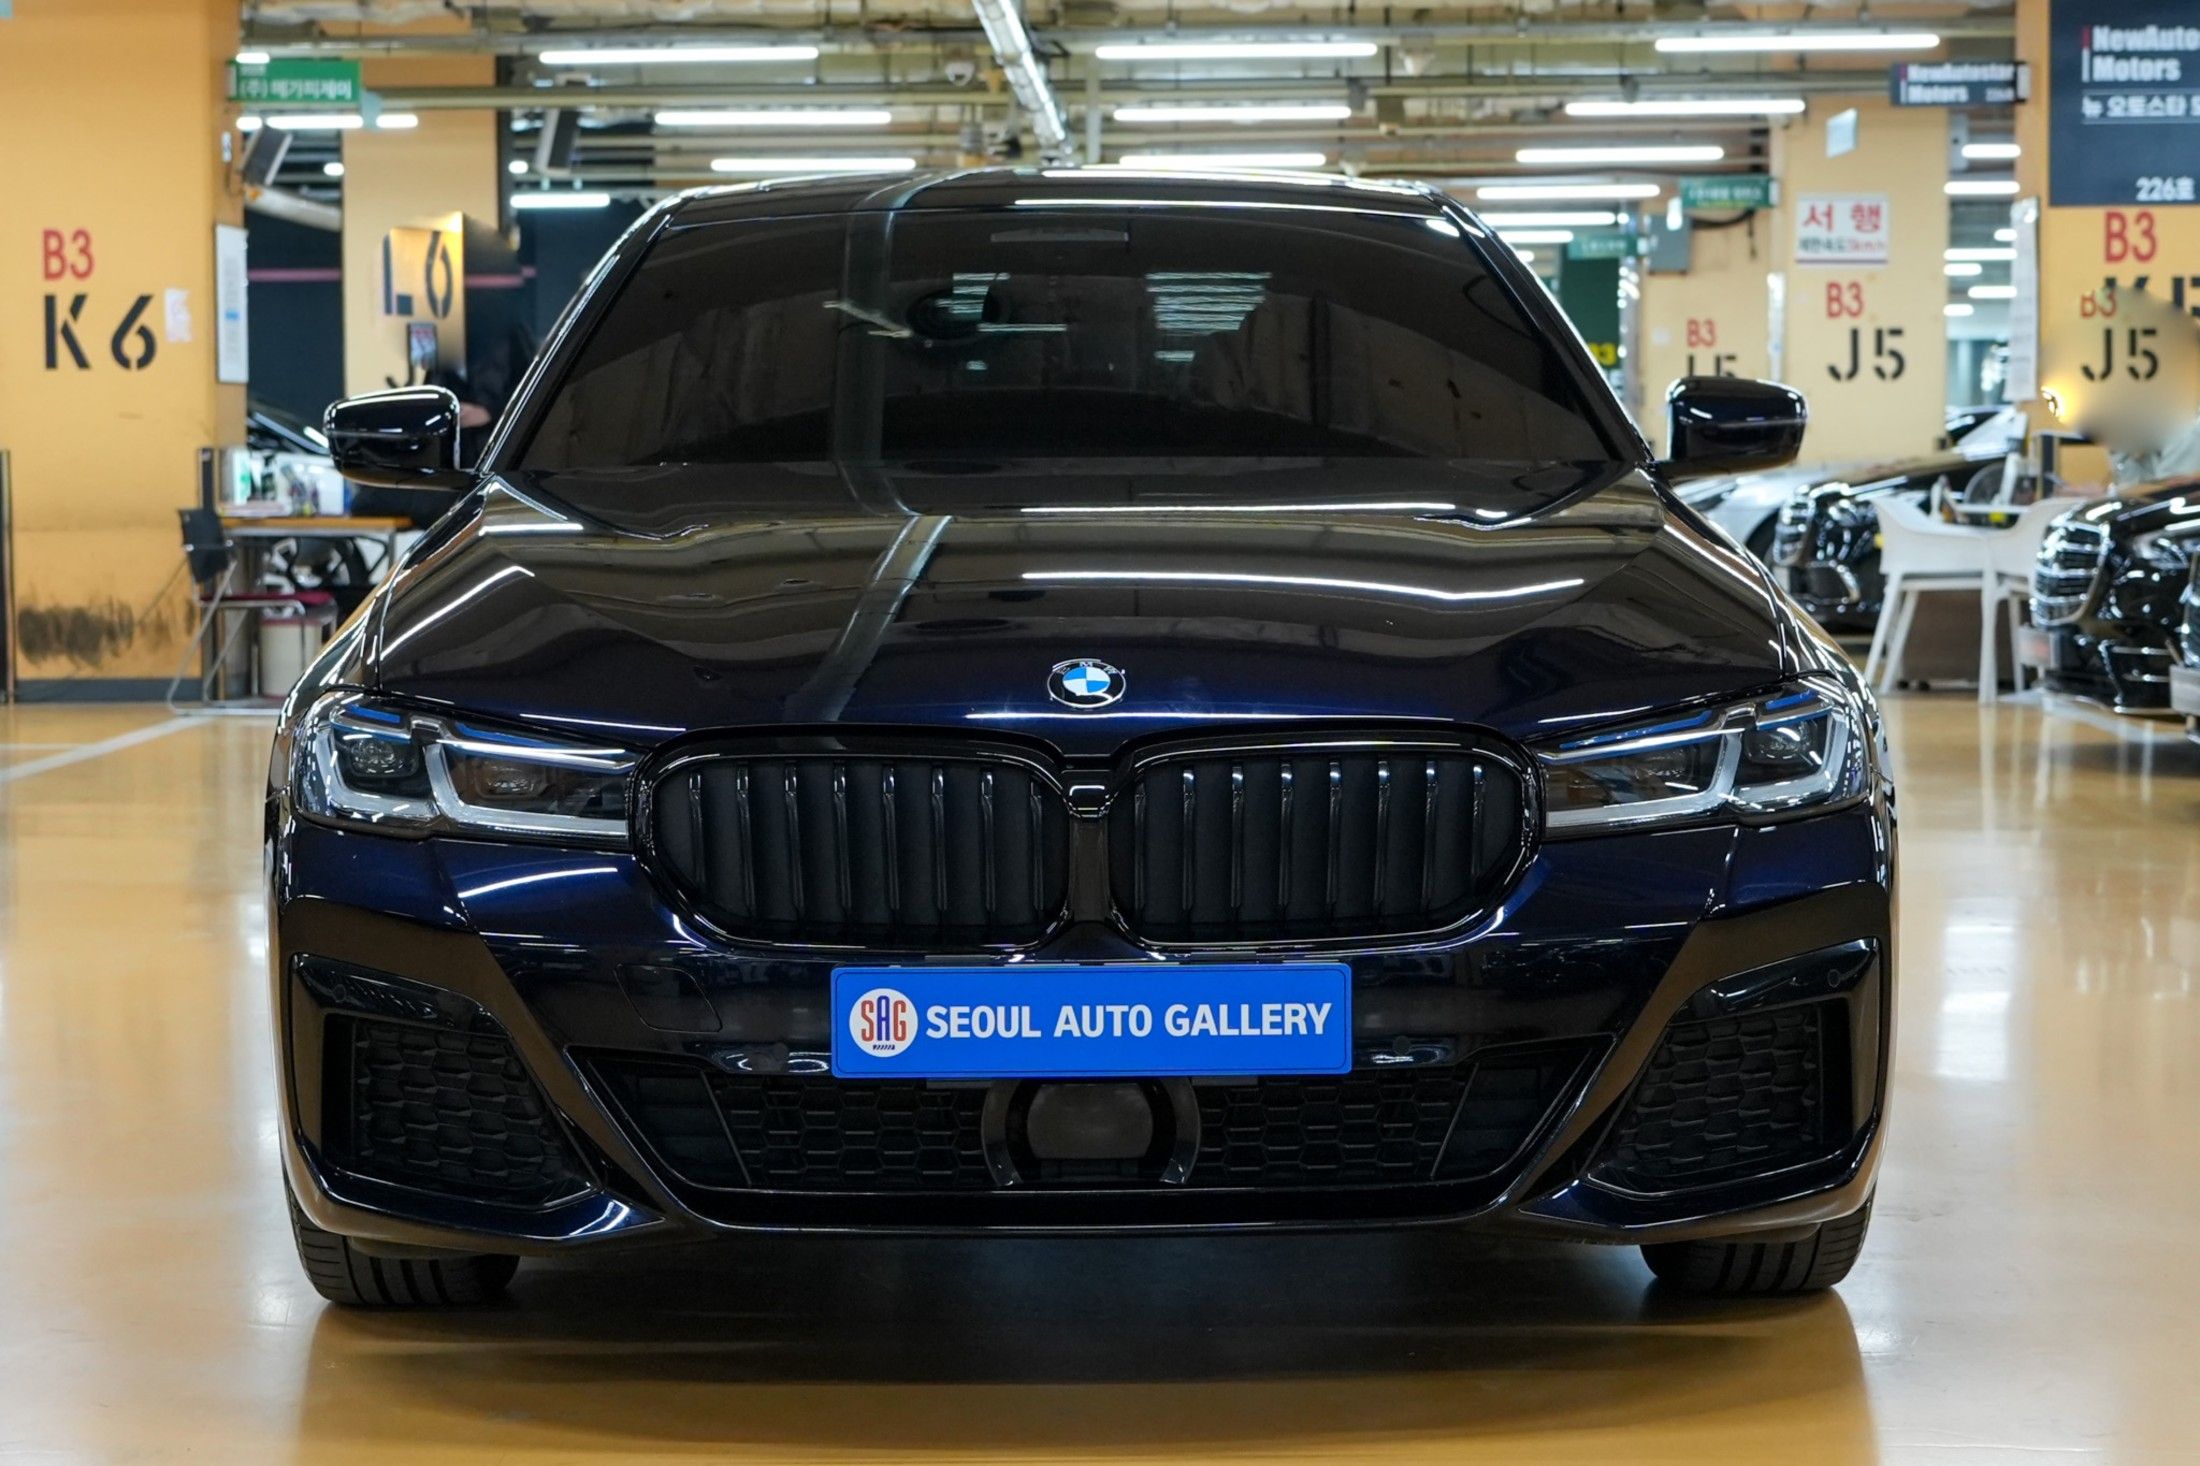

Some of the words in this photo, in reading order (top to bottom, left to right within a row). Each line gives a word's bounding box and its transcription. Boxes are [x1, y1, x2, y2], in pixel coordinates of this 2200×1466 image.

[2092, 55, 2181, 82] Motors
[2135, 176, 2196, 201] 226호
[42, 228, 96, 282] B3
[2104, 210, 2157, 263] B3
[1826, 281, 1864, 320] B3
[1686, 318, 1716, 348] B3
[1827, 328, 1905, 382] J5
[2081, 328, 2158, 381] J5
[860, 994, 908, 1043] SAG
[925, 1004, 1042, 1040] SEOUL
[1053, 1003, 1153, 1038] AUTO
[1164, 1002, 1333, 1037] GALLERY
